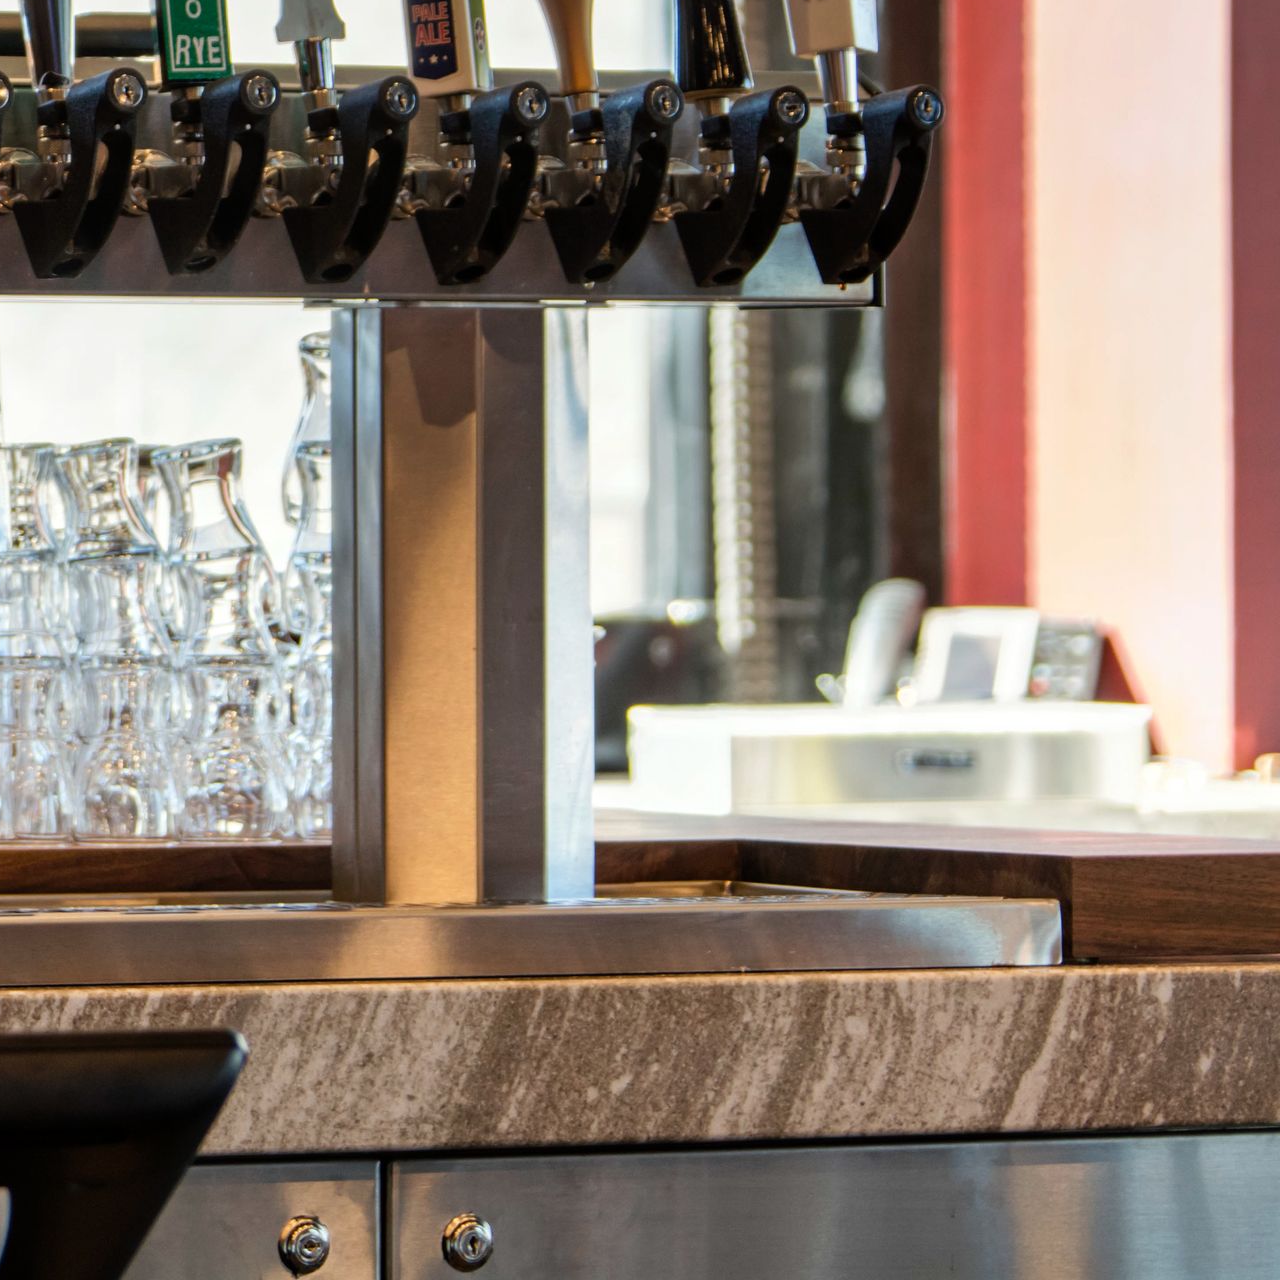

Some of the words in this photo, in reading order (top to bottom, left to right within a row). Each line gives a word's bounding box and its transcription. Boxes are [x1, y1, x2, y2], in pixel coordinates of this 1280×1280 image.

[411, 1, 449, 22] PALE
[415, 22, 451, 48] ALE
[175, 33, 222, 66] RYE
